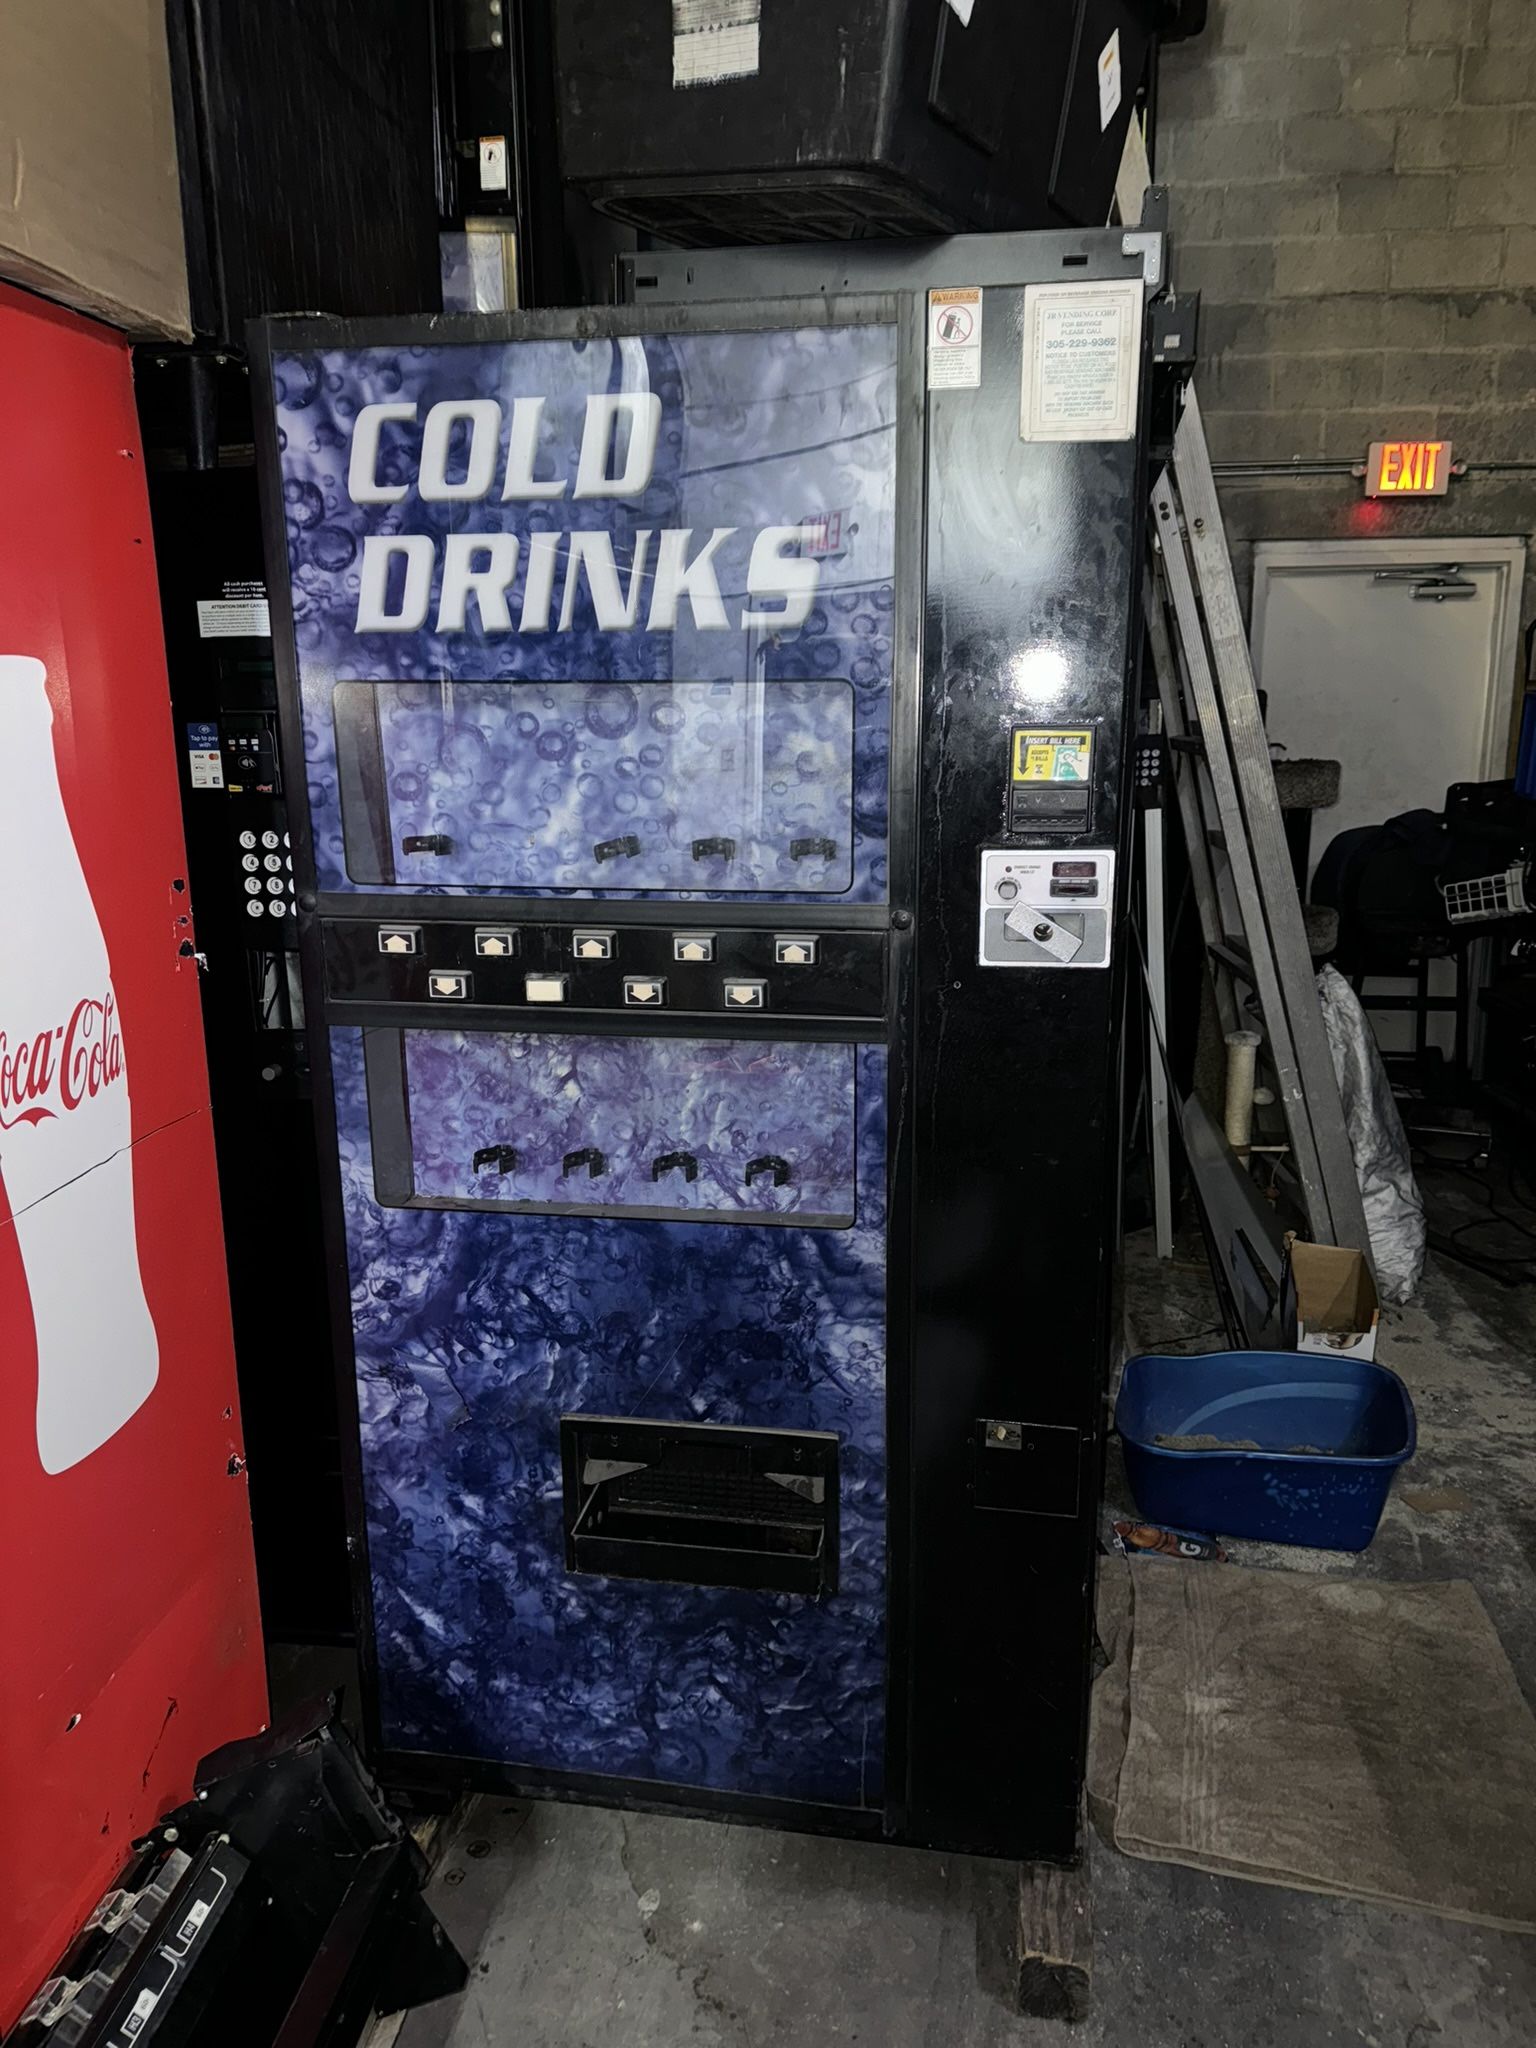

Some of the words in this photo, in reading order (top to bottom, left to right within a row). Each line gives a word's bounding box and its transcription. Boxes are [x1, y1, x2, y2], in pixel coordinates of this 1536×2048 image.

[943, 291, 979, 301] WARNING
[1058, 310, 1093, 319] VENDING
[1046, 337, 1117, 349] 305-229-9362
[1079, 350, 1116, 358] CUSTOMERS
[347, 391, 662, 504] COLD
[1380, 443, 1442, 490] EXIT
[354, 525, 827, 634] DRINKS
[1025, 736, 1048, 744] INSERT
[0, 992, 121, 1128] oca-Cola
